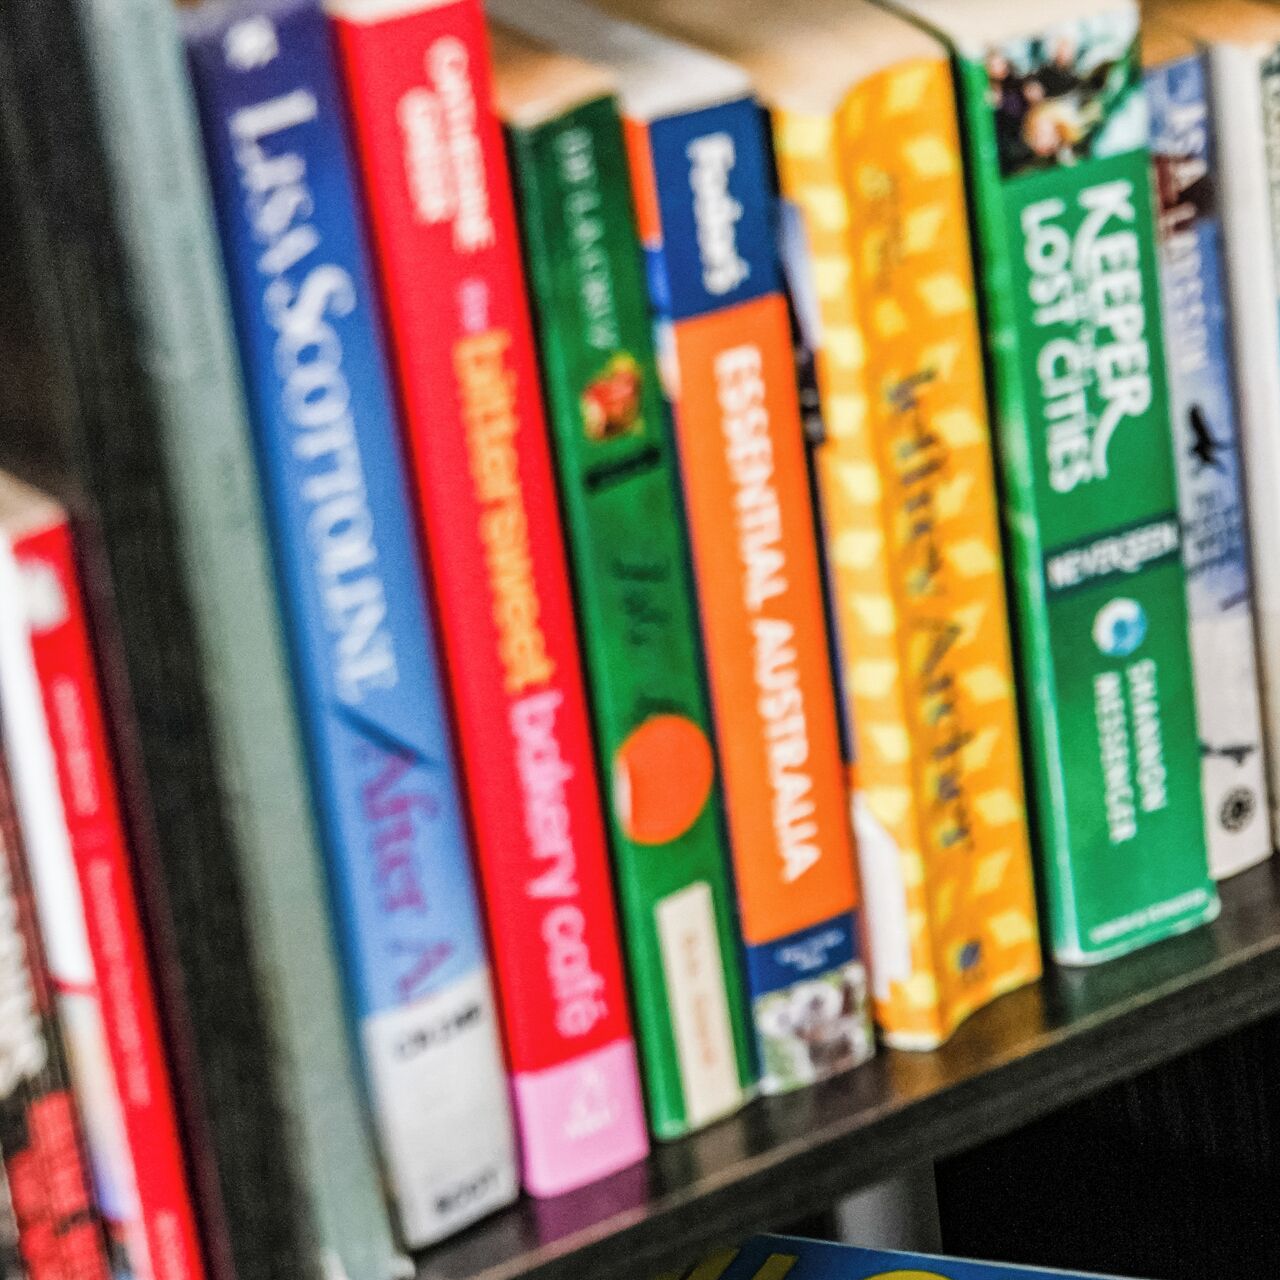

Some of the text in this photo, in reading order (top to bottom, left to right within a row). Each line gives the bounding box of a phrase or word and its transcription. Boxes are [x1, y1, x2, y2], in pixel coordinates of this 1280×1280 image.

[229, 88, 320, 275] LISA
[1021, 198, 1078, 330] LOST
[1072, 180, 1152, 478] KEEPER
[264, 264, 398, 700] SCOTTOLINE
[453, 330, 608, 1037] bittersweet bakery café
[714, 343, 789, 611] ESSENTIAL
[754, 618, 822, 882] AUSTRALIA
[1093, 671, 1138, 845] MESSENGER
[1126, 657, 1169, 813] SHANNON
